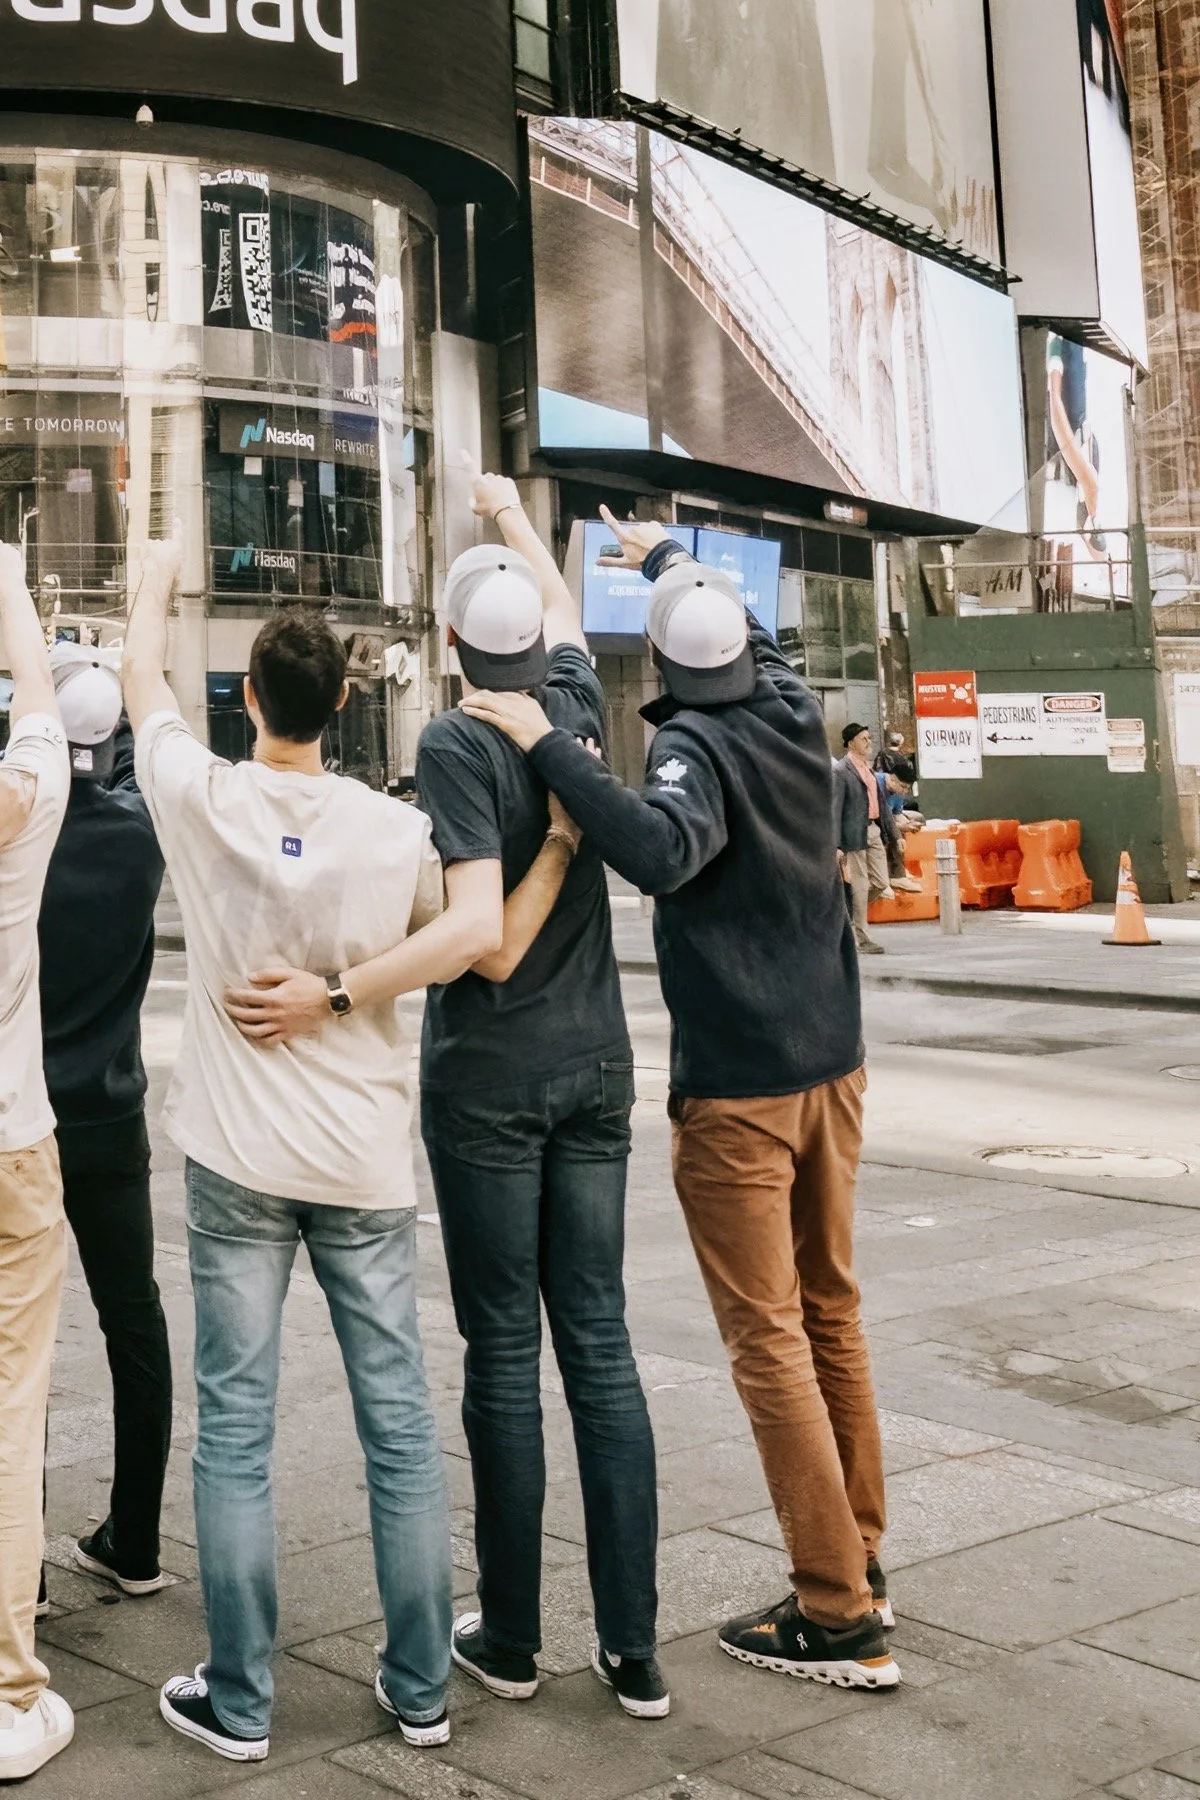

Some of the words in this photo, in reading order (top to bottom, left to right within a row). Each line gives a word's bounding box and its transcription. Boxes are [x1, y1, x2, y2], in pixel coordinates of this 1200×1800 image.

[24, 416, 122, 434] TOMORROW
[266, 426, 314, 451] Nasdaq
[334, 437, 376, 459] REWRITE
[983, 706, 1037, 724] PEDESTRIANS
[925, 729, 972, 748] SUBWAY
